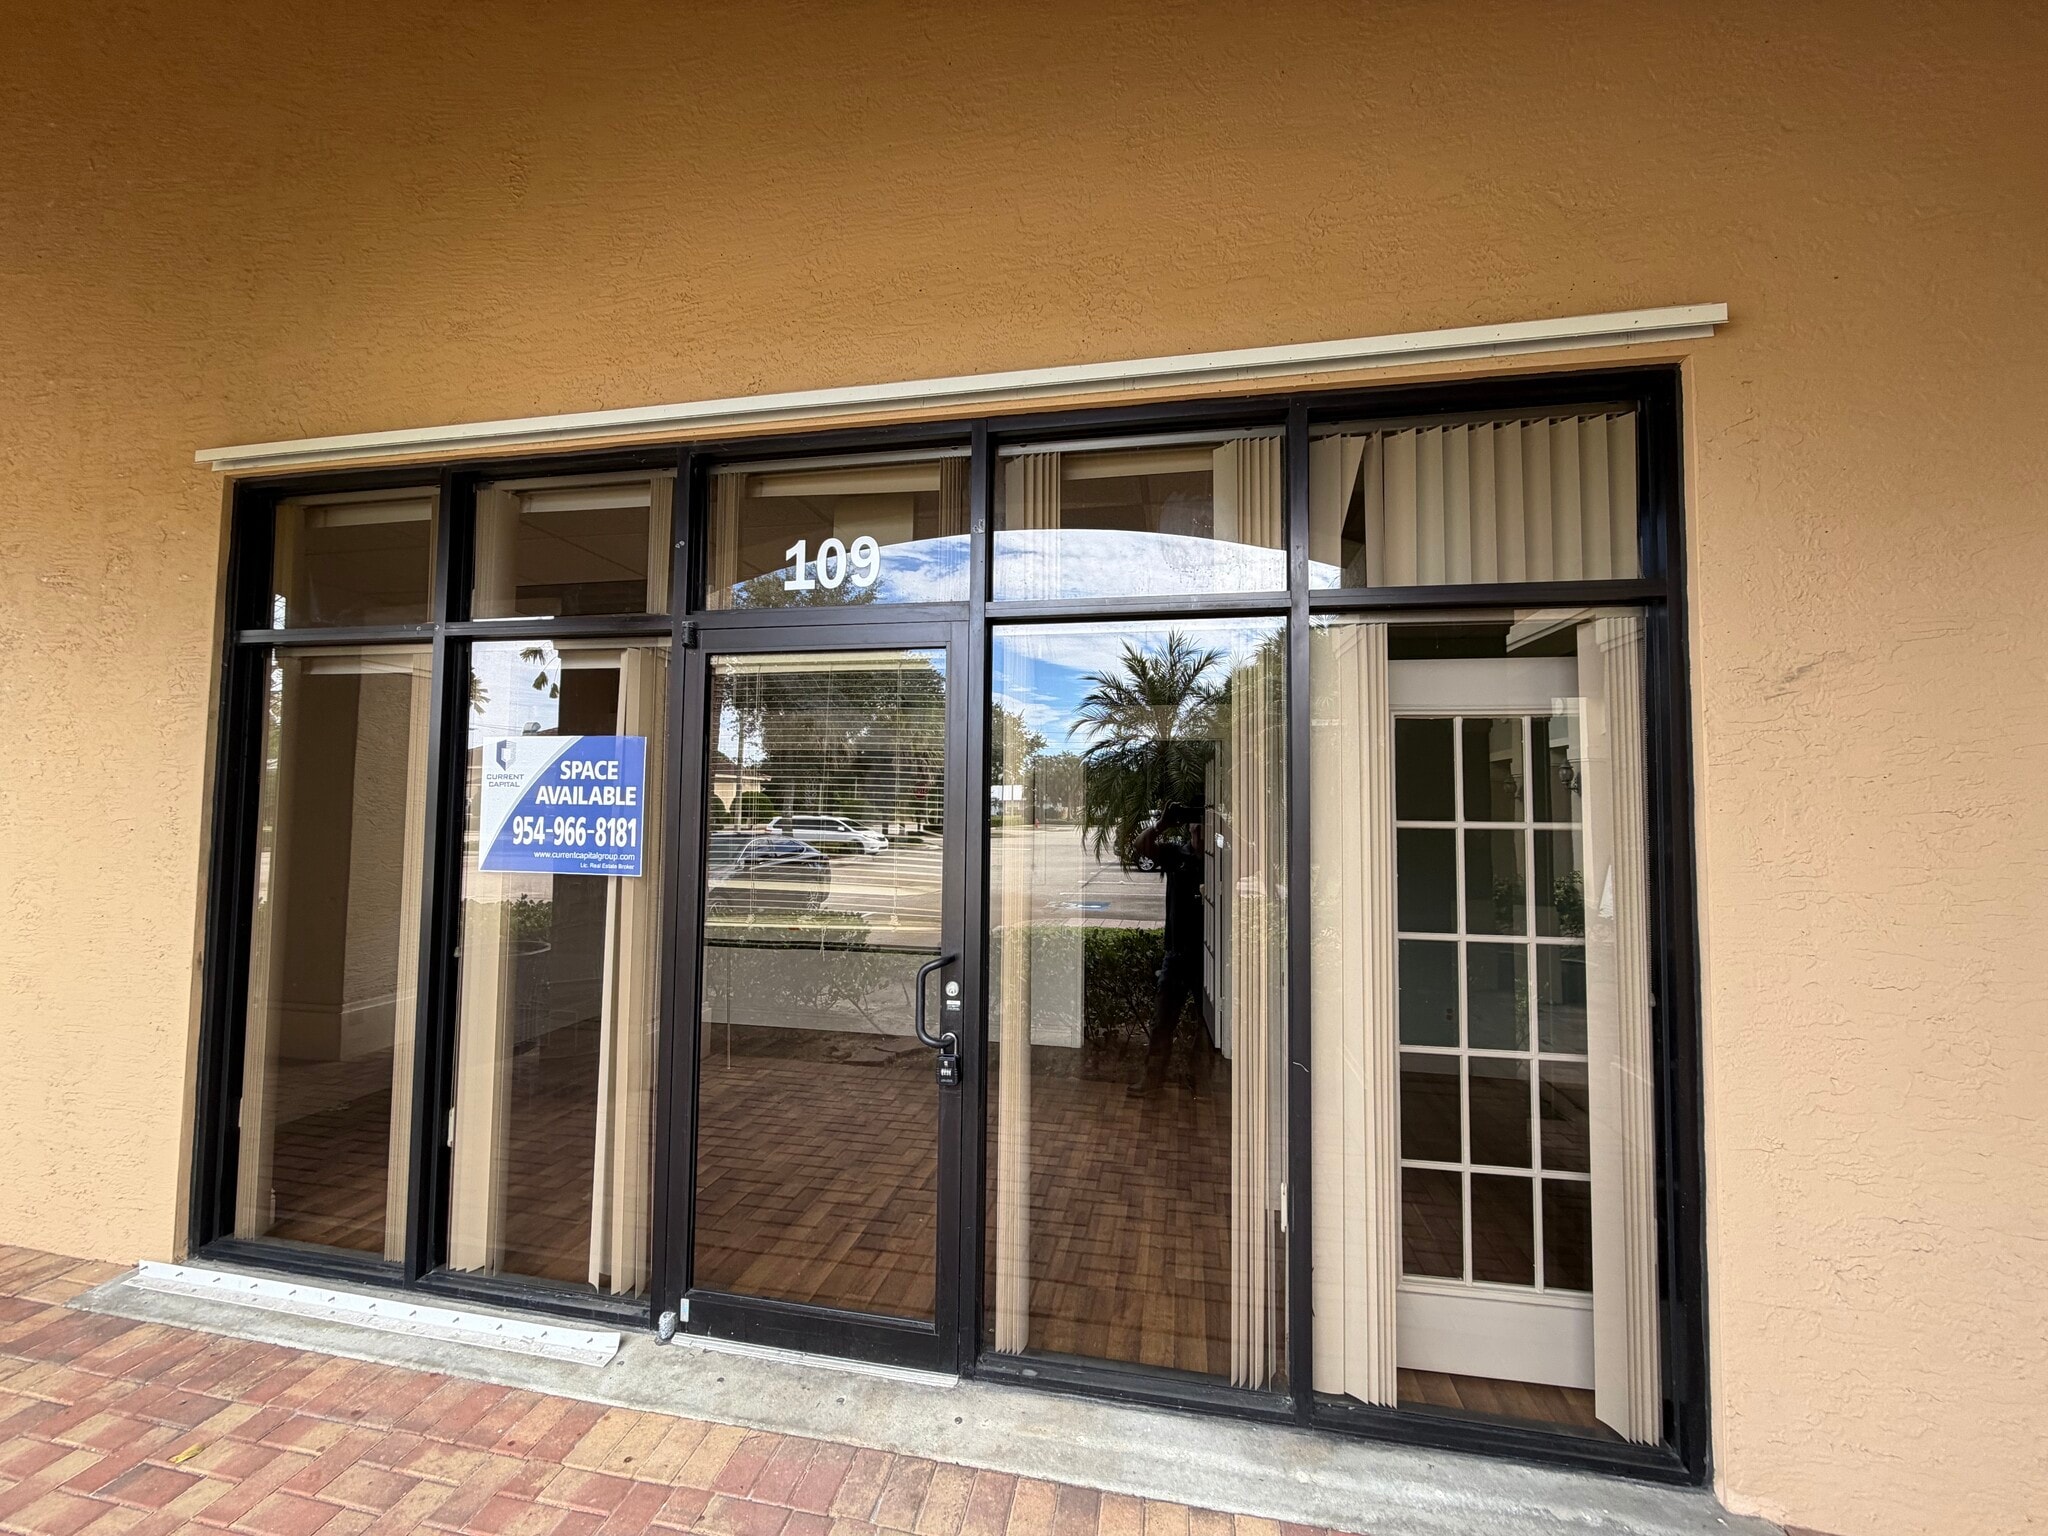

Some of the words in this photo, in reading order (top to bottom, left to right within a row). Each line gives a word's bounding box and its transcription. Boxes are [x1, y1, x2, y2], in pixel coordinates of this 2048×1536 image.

[783, 534, 882, 592] 109
[559, 760, 619, 780] SPACE
[535, 785, 637, 806] AVAILABLE
[512, 815, 637, 848] 954-966-8181
[533, 851, 635, 861] www.currentcapitalgroup.com
